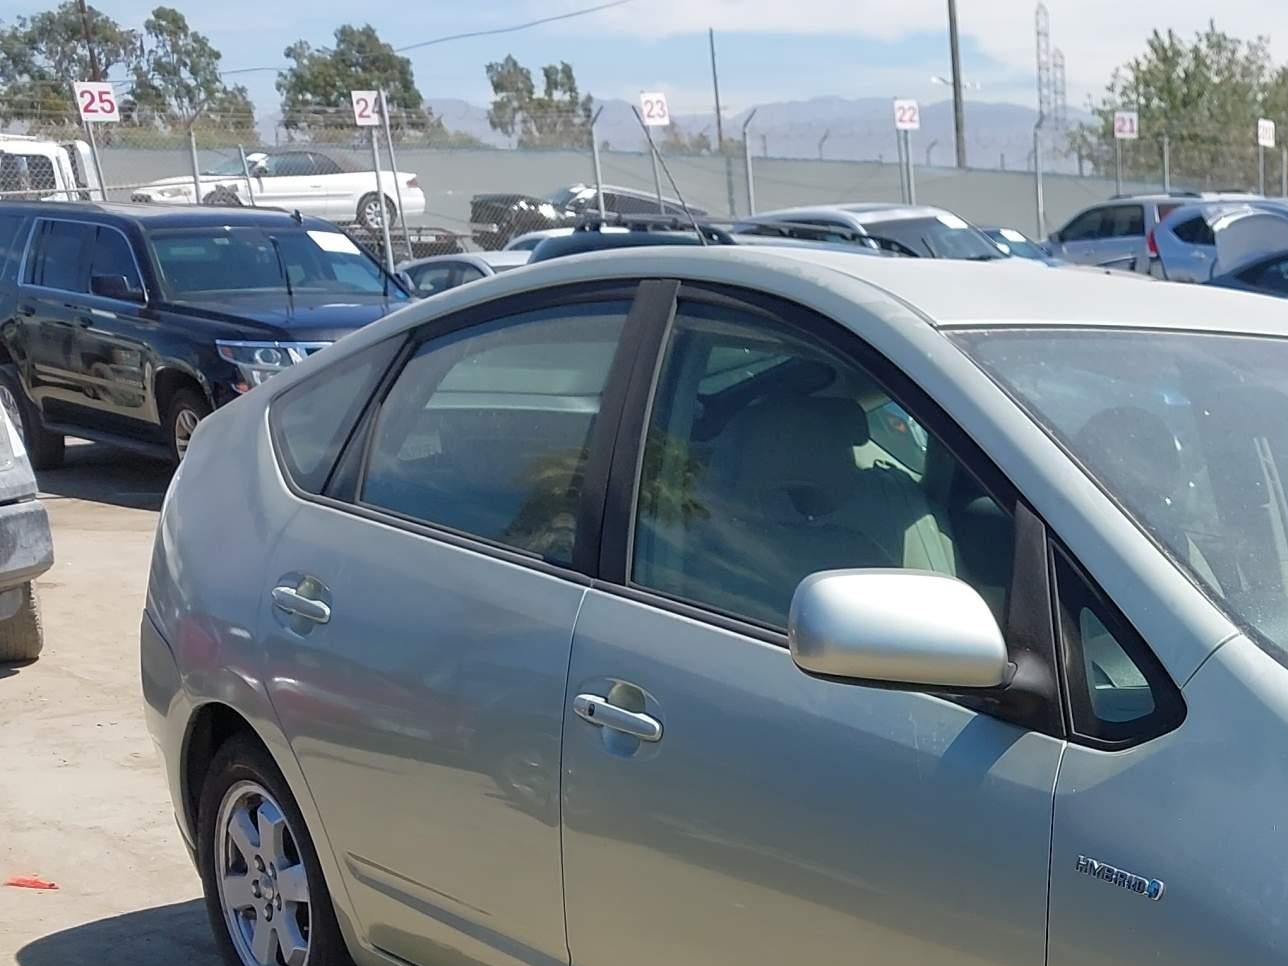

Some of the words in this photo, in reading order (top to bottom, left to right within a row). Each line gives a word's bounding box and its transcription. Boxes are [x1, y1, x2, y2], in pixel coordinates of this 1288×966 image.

[79, 90, 115, 114] 25
[643, 99, 667, 119] 23
[895, 106, 917, 123] 22
[1115, 116, 1137, 134] 21
[1075, 854, 1150, 896] HYBRID
